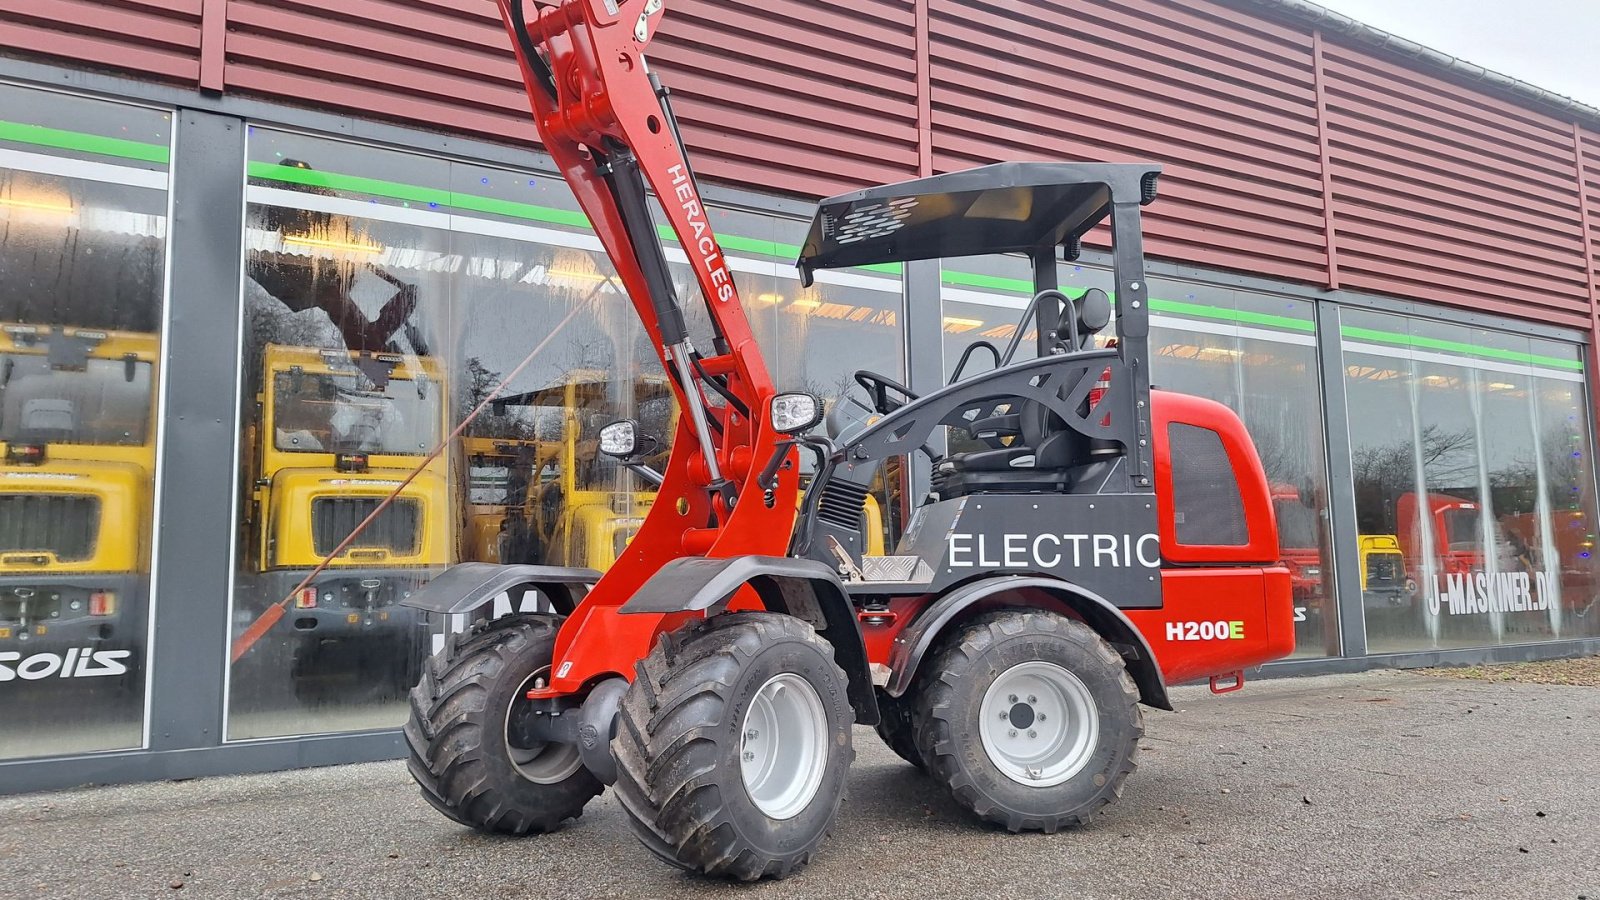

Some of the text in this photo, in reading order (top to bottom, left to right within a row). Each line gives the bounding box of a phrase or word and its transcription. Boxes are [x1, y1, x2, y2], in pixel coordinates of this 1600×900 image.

[667, 163, 734, 303] HERACLES
[948, 532, 1161, 568] ELECTRIC
[1165, 620, 1245, 641] H200E
